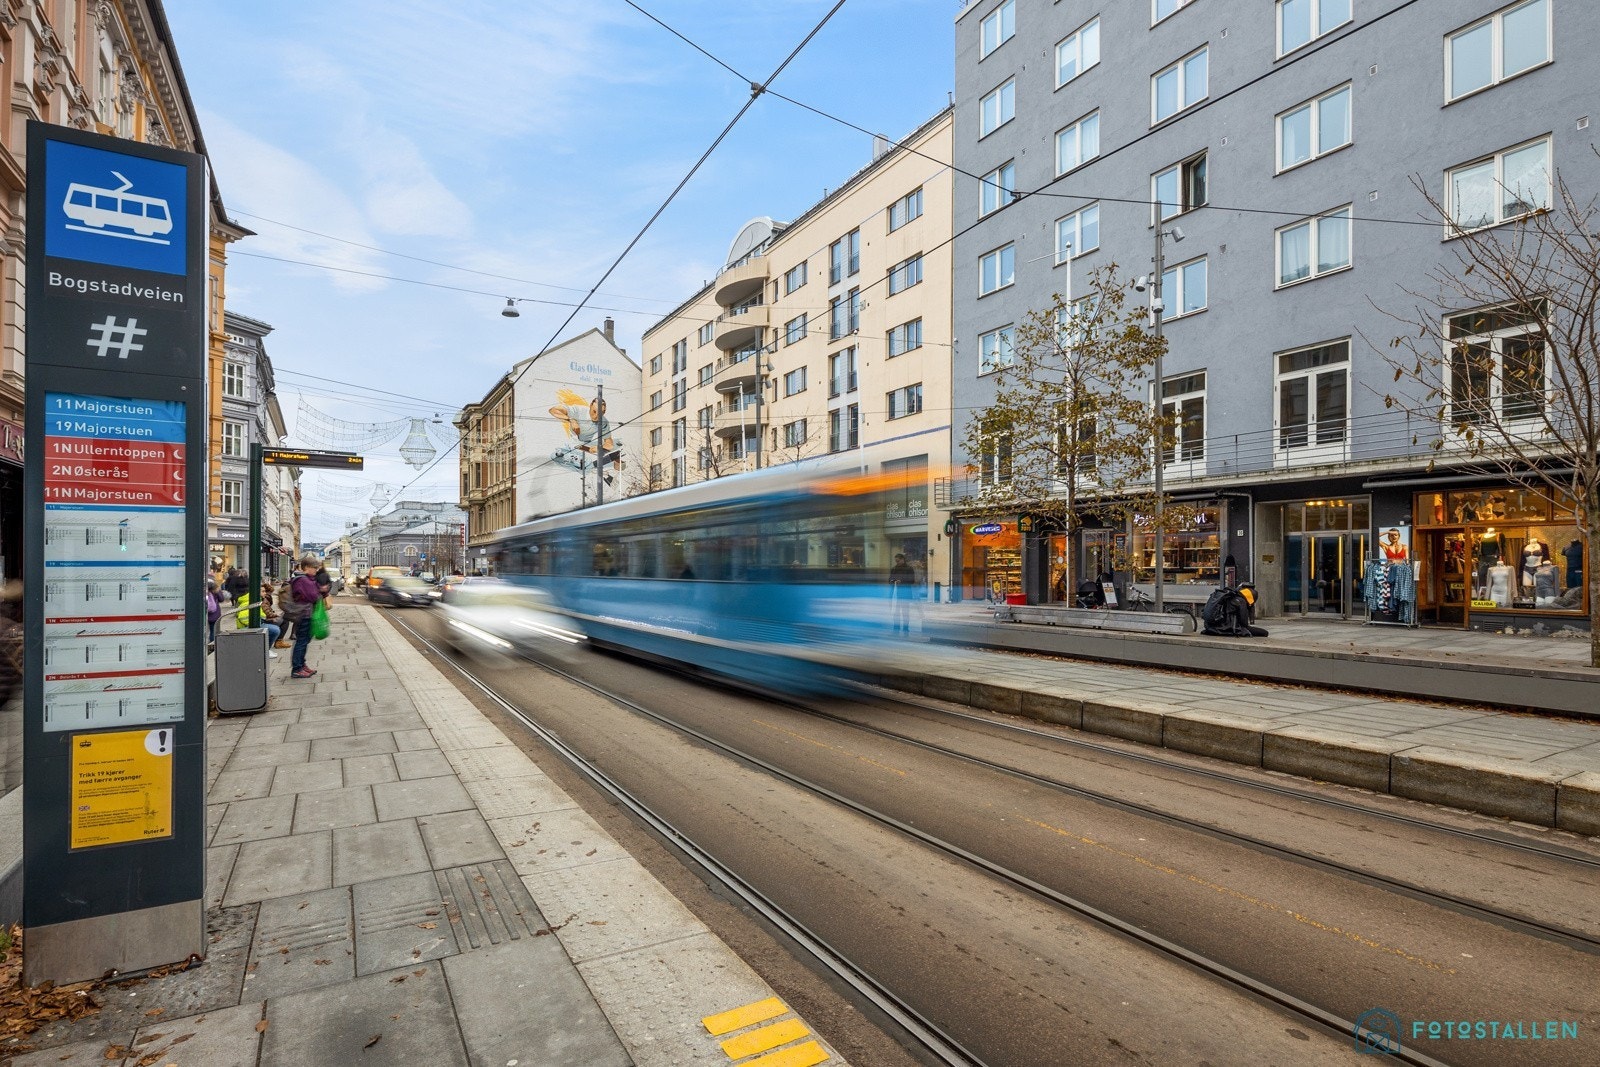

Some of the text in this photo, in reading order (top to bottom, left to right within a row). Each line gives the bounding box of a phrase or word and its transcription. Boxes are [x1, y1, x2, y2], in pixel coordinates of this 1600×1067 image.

[49, 271, 183, 303] Bogstadveien
[56, 398, 153, 415] 11 Majorstuen
[56, 421, 153, 436] 19 Majorstuen
[53, 443, 165, 460] 1N Ullerntoppen
[52, 465, 128, 478] 2N Østerås
[45, 487, 153, 501] 11N Majorstuen
